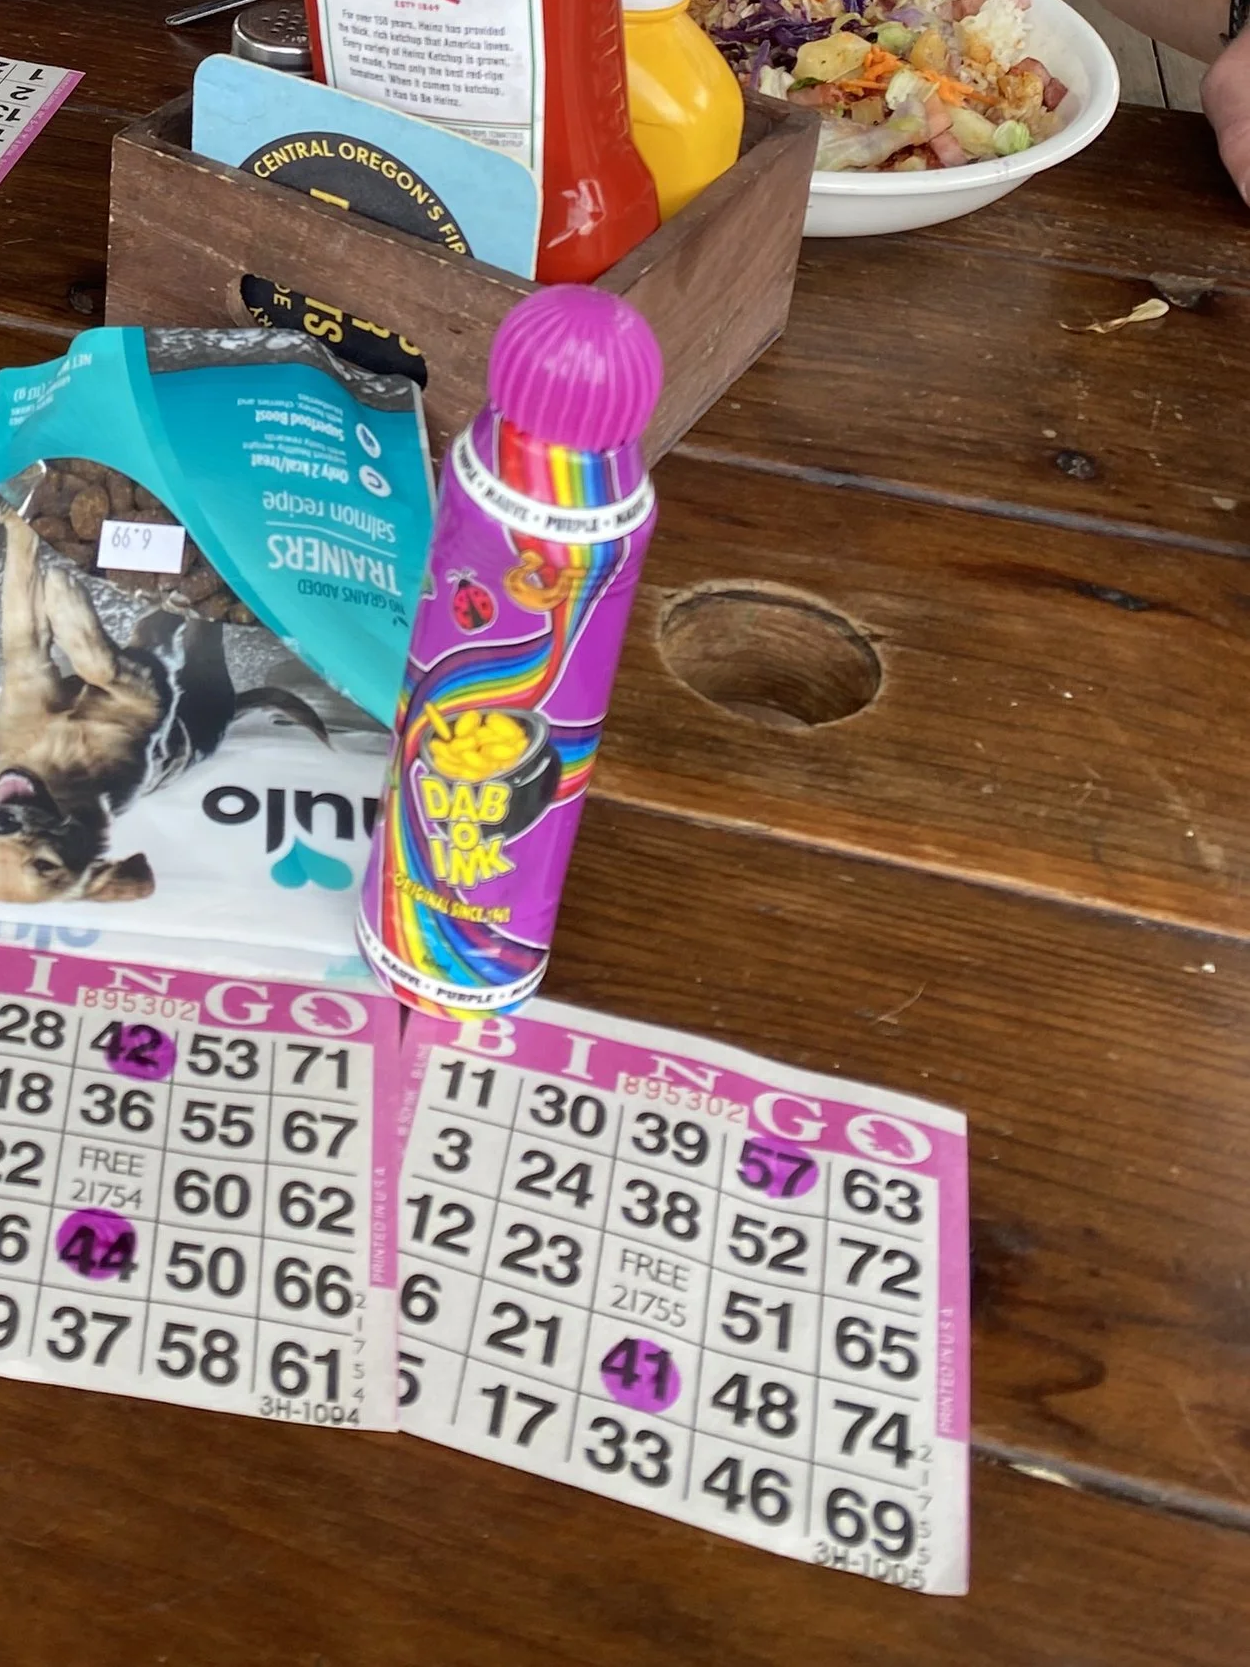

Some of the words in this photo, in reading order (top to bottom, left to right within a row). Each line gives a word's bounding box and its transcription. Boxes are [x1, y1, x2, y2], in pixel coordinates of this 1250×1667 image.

[28, 68, 44, 81] 1
[253, 140, 335, 178] CENTRAL
[338, 142, 445, 221] OREGON'S
[439, 222, 468, 255] FIR
[255, 410, 288, 425] Boost
[290, 413, 345, 442] Superfood
[251, 454, 309, 478] kcal/treat
[311, 463, 320, 479] 2
[321, 463, 349, 484] Only
[262, 490, 325, 518] recipe
[112, 526, 152, 551] 6.99
[330, 502, 395, 543] salmon
[267, 534, 402, 596] TRAINERS
[297, 579, 339, 600] ADDED
[341, 587, 387, 609] GRAINS
[420, 777, 511, 823] DAB
[430, 835, 516, 888] INK
[394, 871, 450, 915] ORIGINAL
[82, 986, 199, 1021] 895302
[437, 987, 494, 1004] PURPLE
[90, 1020, 163, 1067] 42
[187, 1033, 258, 1080] 53
[287, 1044, 348, 1088] 71
[622, 1074, 748, 1123] 895302
[441, 1061, 495, 1106] 11
[530, 1084, 605, 1137] 30
[632, 1112, 708, 1165] 39
[740, 1140, 813, 1196] 57
[843, 1167, 921, 1223] 63
[70, 1179, 142, 1210] 21754
[78, 1146, 145, 1178] FREE
[174, 1169, 250, 1219] 60
[279, 1180, 353, 1235] 62
[407, 1194, 474, 1254] 12
[500, 1223, 581, 1285] 23
[618, 1248, 691, 1290] FREE
[722, 1290, 791, 1350] 51
[835, 1316, 917, 1379] 65
[611, 1287, 687, 1328] 21755
